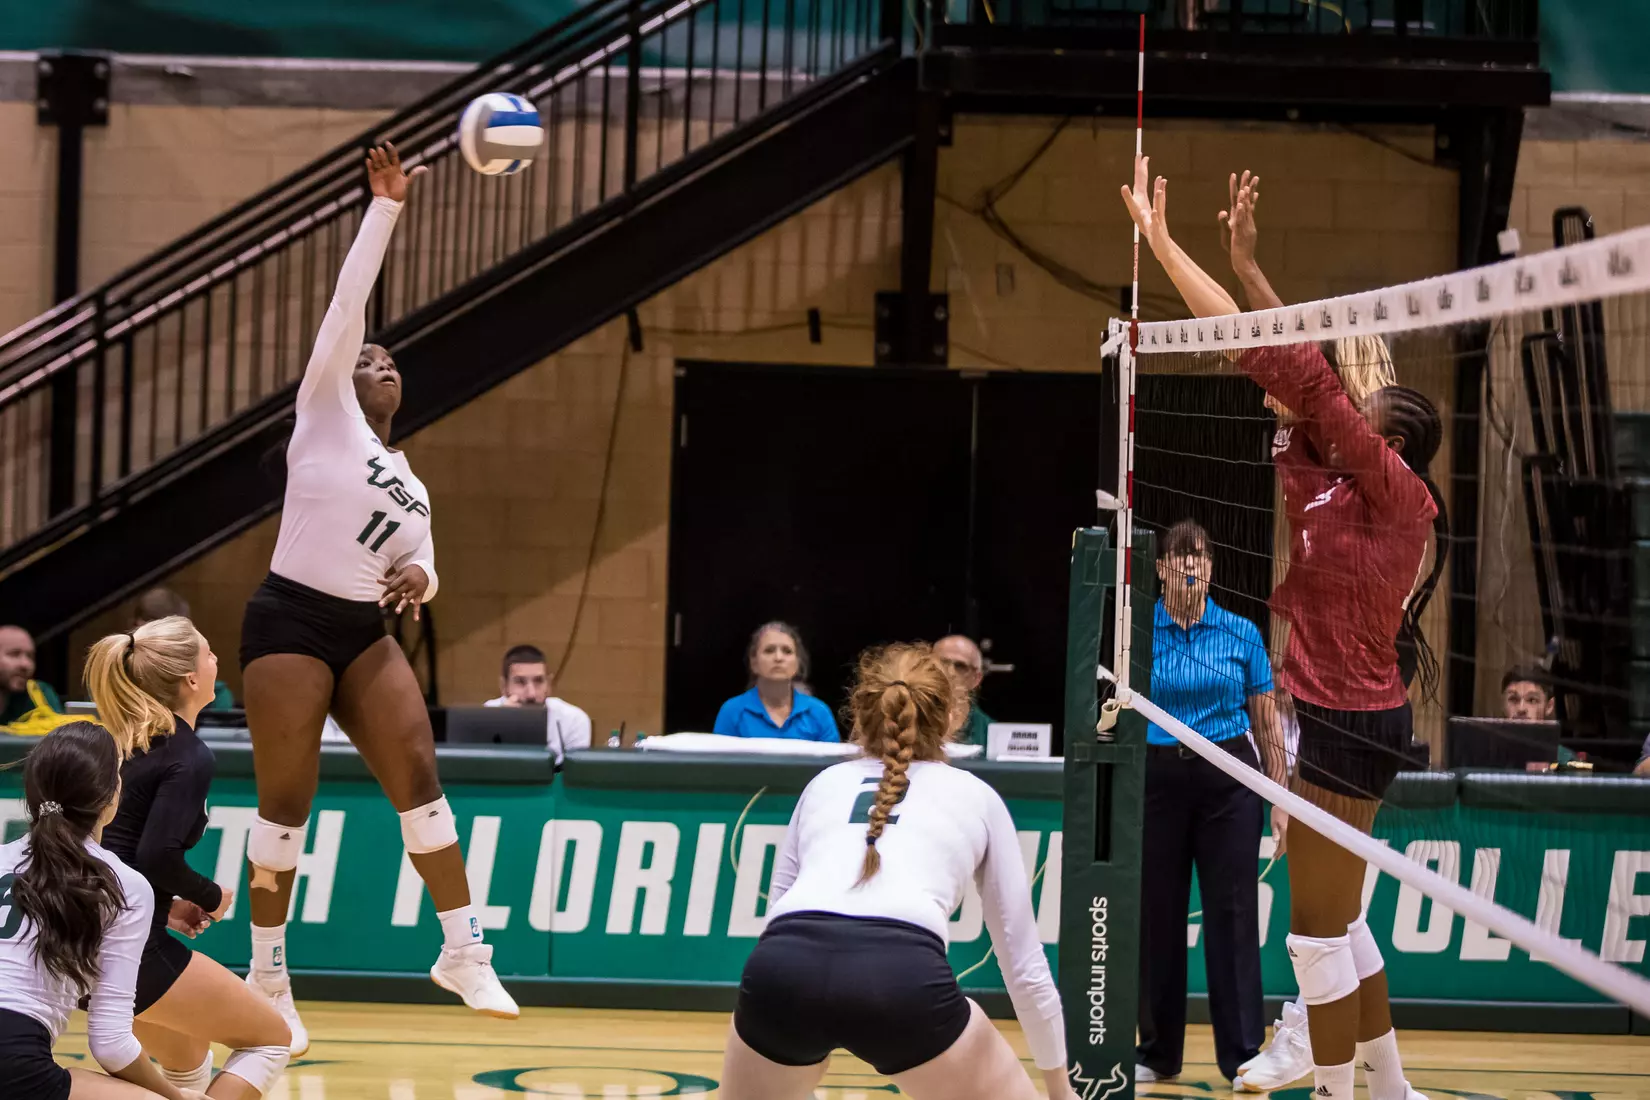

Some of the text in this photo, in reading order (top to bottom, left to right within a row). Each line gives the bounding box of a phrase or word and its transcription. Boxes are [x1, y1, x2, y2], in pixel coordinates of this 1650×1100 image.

[367, 456, 430, 518] USF
[356, 510, 401, 553] 11
[848, 777, 911, 825] 2
[391, 815, 788, 938] LORID
[1086, 895, 1110, 1046] sports imports
